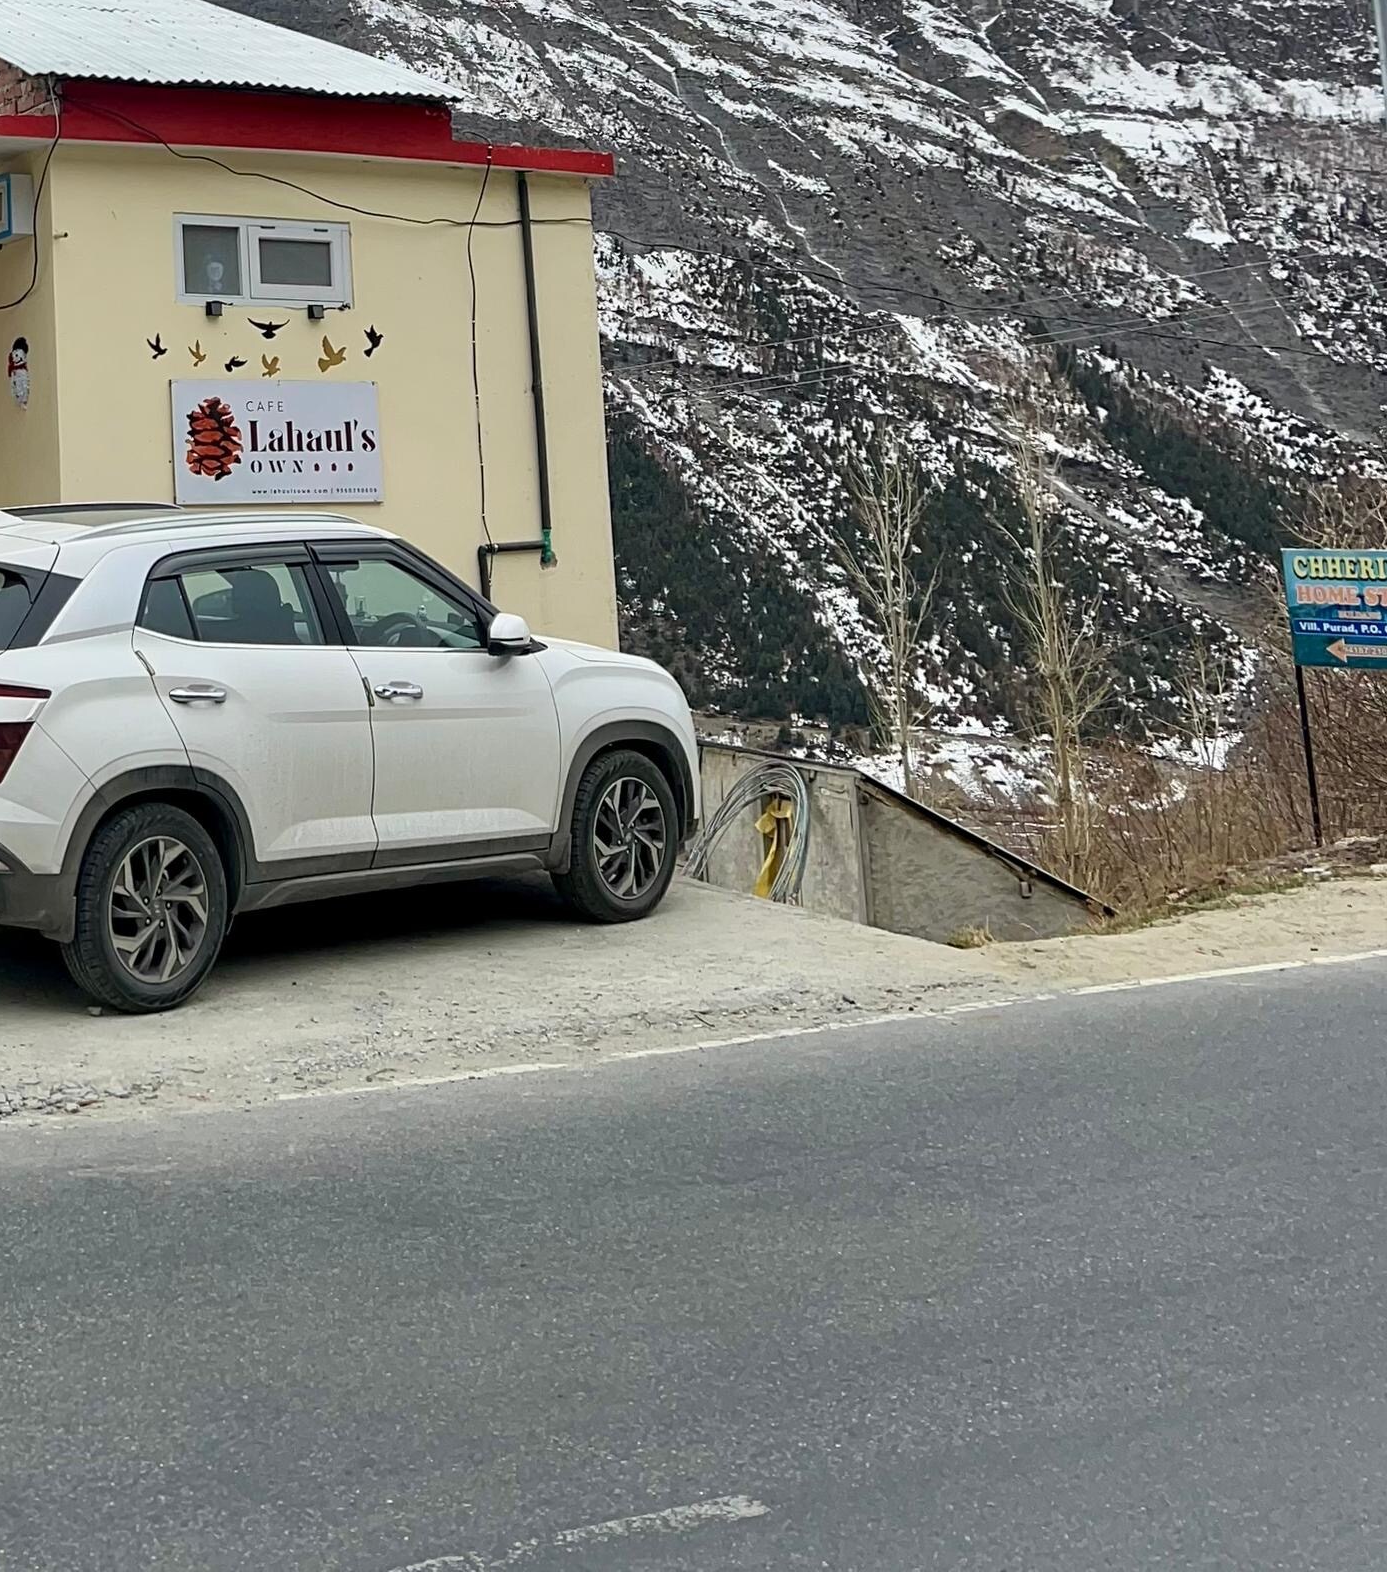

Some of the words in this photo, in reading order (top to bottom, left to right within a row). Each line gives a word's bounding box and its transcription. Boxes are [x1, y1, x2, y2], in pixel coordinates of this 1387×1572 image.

[246, 401, 284, 412] CAFE
[248, 419, 376, 452] Lahaul's
[250, 460, 303, 473] OWN
[1293, 556, 1386, 581] CHHERI
[1296, 584, 1361, 605] HOME
[1363, 586, 1387, 606] ST
[1299, 621, 1320, 631] Vill.
[1323, 623, 1358, 634] Purad,
[1360, 624, 1382, 633] P.O.
